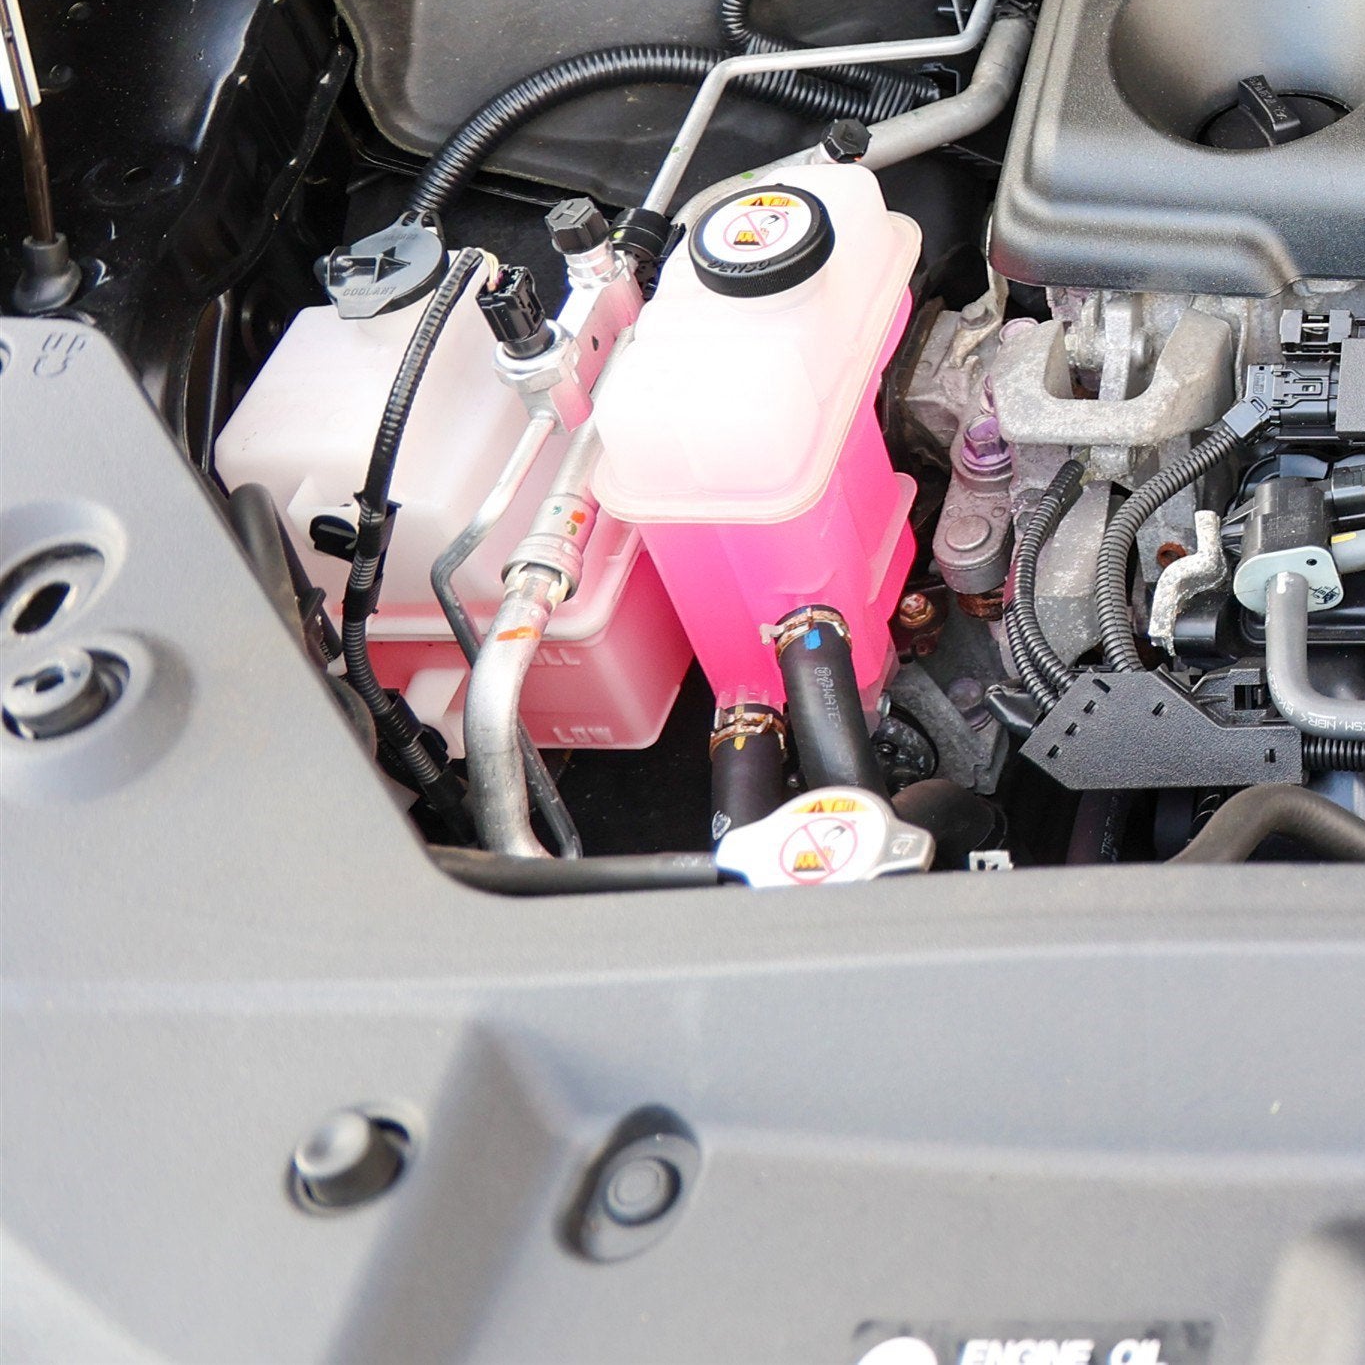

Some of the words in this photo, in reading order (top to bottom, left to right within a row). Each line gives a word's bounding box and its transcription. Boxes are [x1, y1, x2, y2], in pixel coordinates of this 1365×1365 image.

[706, 258, 771, 274] DENSO
[342, 286, 397, 297] COOLANT
[552, 726, 614, 744] LOW
[958, 1338, 1094, 1365] ENGINE
